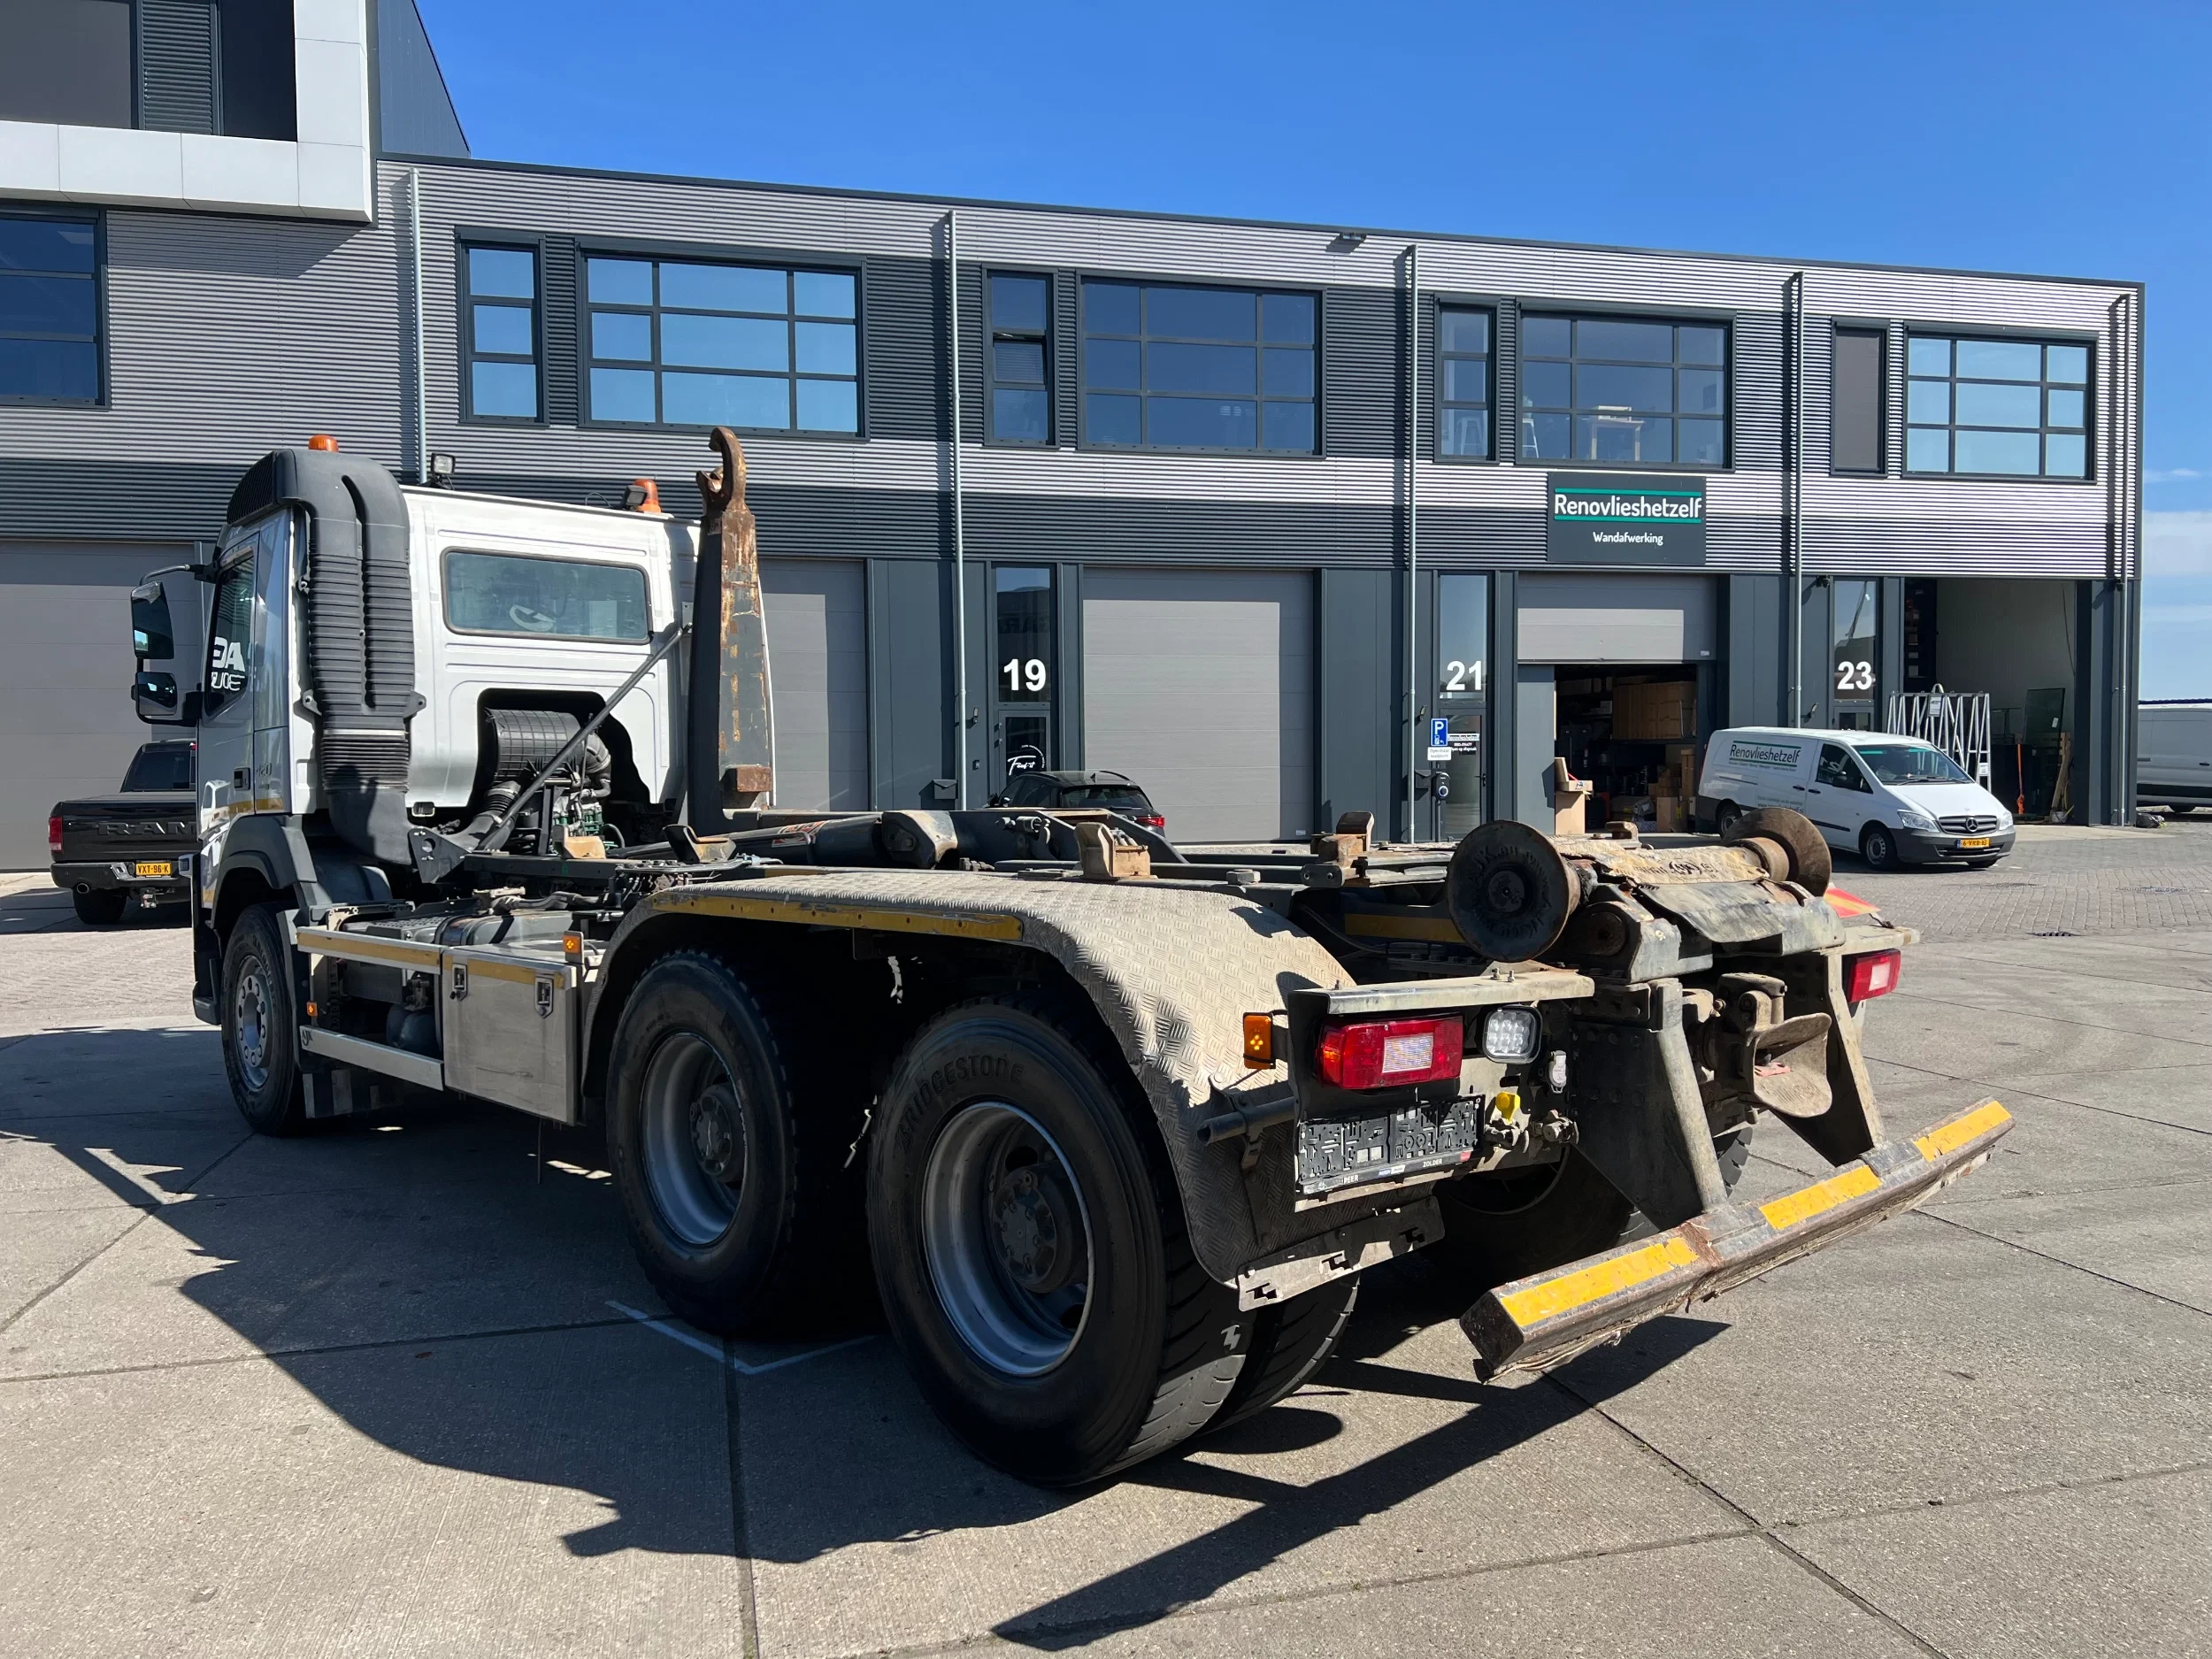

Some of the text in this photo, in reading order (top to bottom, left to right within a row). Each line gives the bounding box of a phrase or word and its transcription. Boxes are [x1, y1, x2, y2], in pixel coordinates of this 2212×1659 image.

[1555, 494, 1701, 518] Renovlieshetzelf
[1593, 532, 1663, 546] Wandafwerking
[1003, 658, 1047, 691] 19
[1446, 661, 1481, 690] 21
[1837, 661, 1872, 690] 23
[1434, 721, 1444, 735] P
[1730, 744, 1801, 764] Renovlieshetzelf
[97, 821, 196, 835] RAM
[137, 863, 169, 874] VXT-96-K
[895, 1055, 1025, 1155] BRIDGESTONE
[1343, 1158, 1443, 1184] PEER ZOLDER
